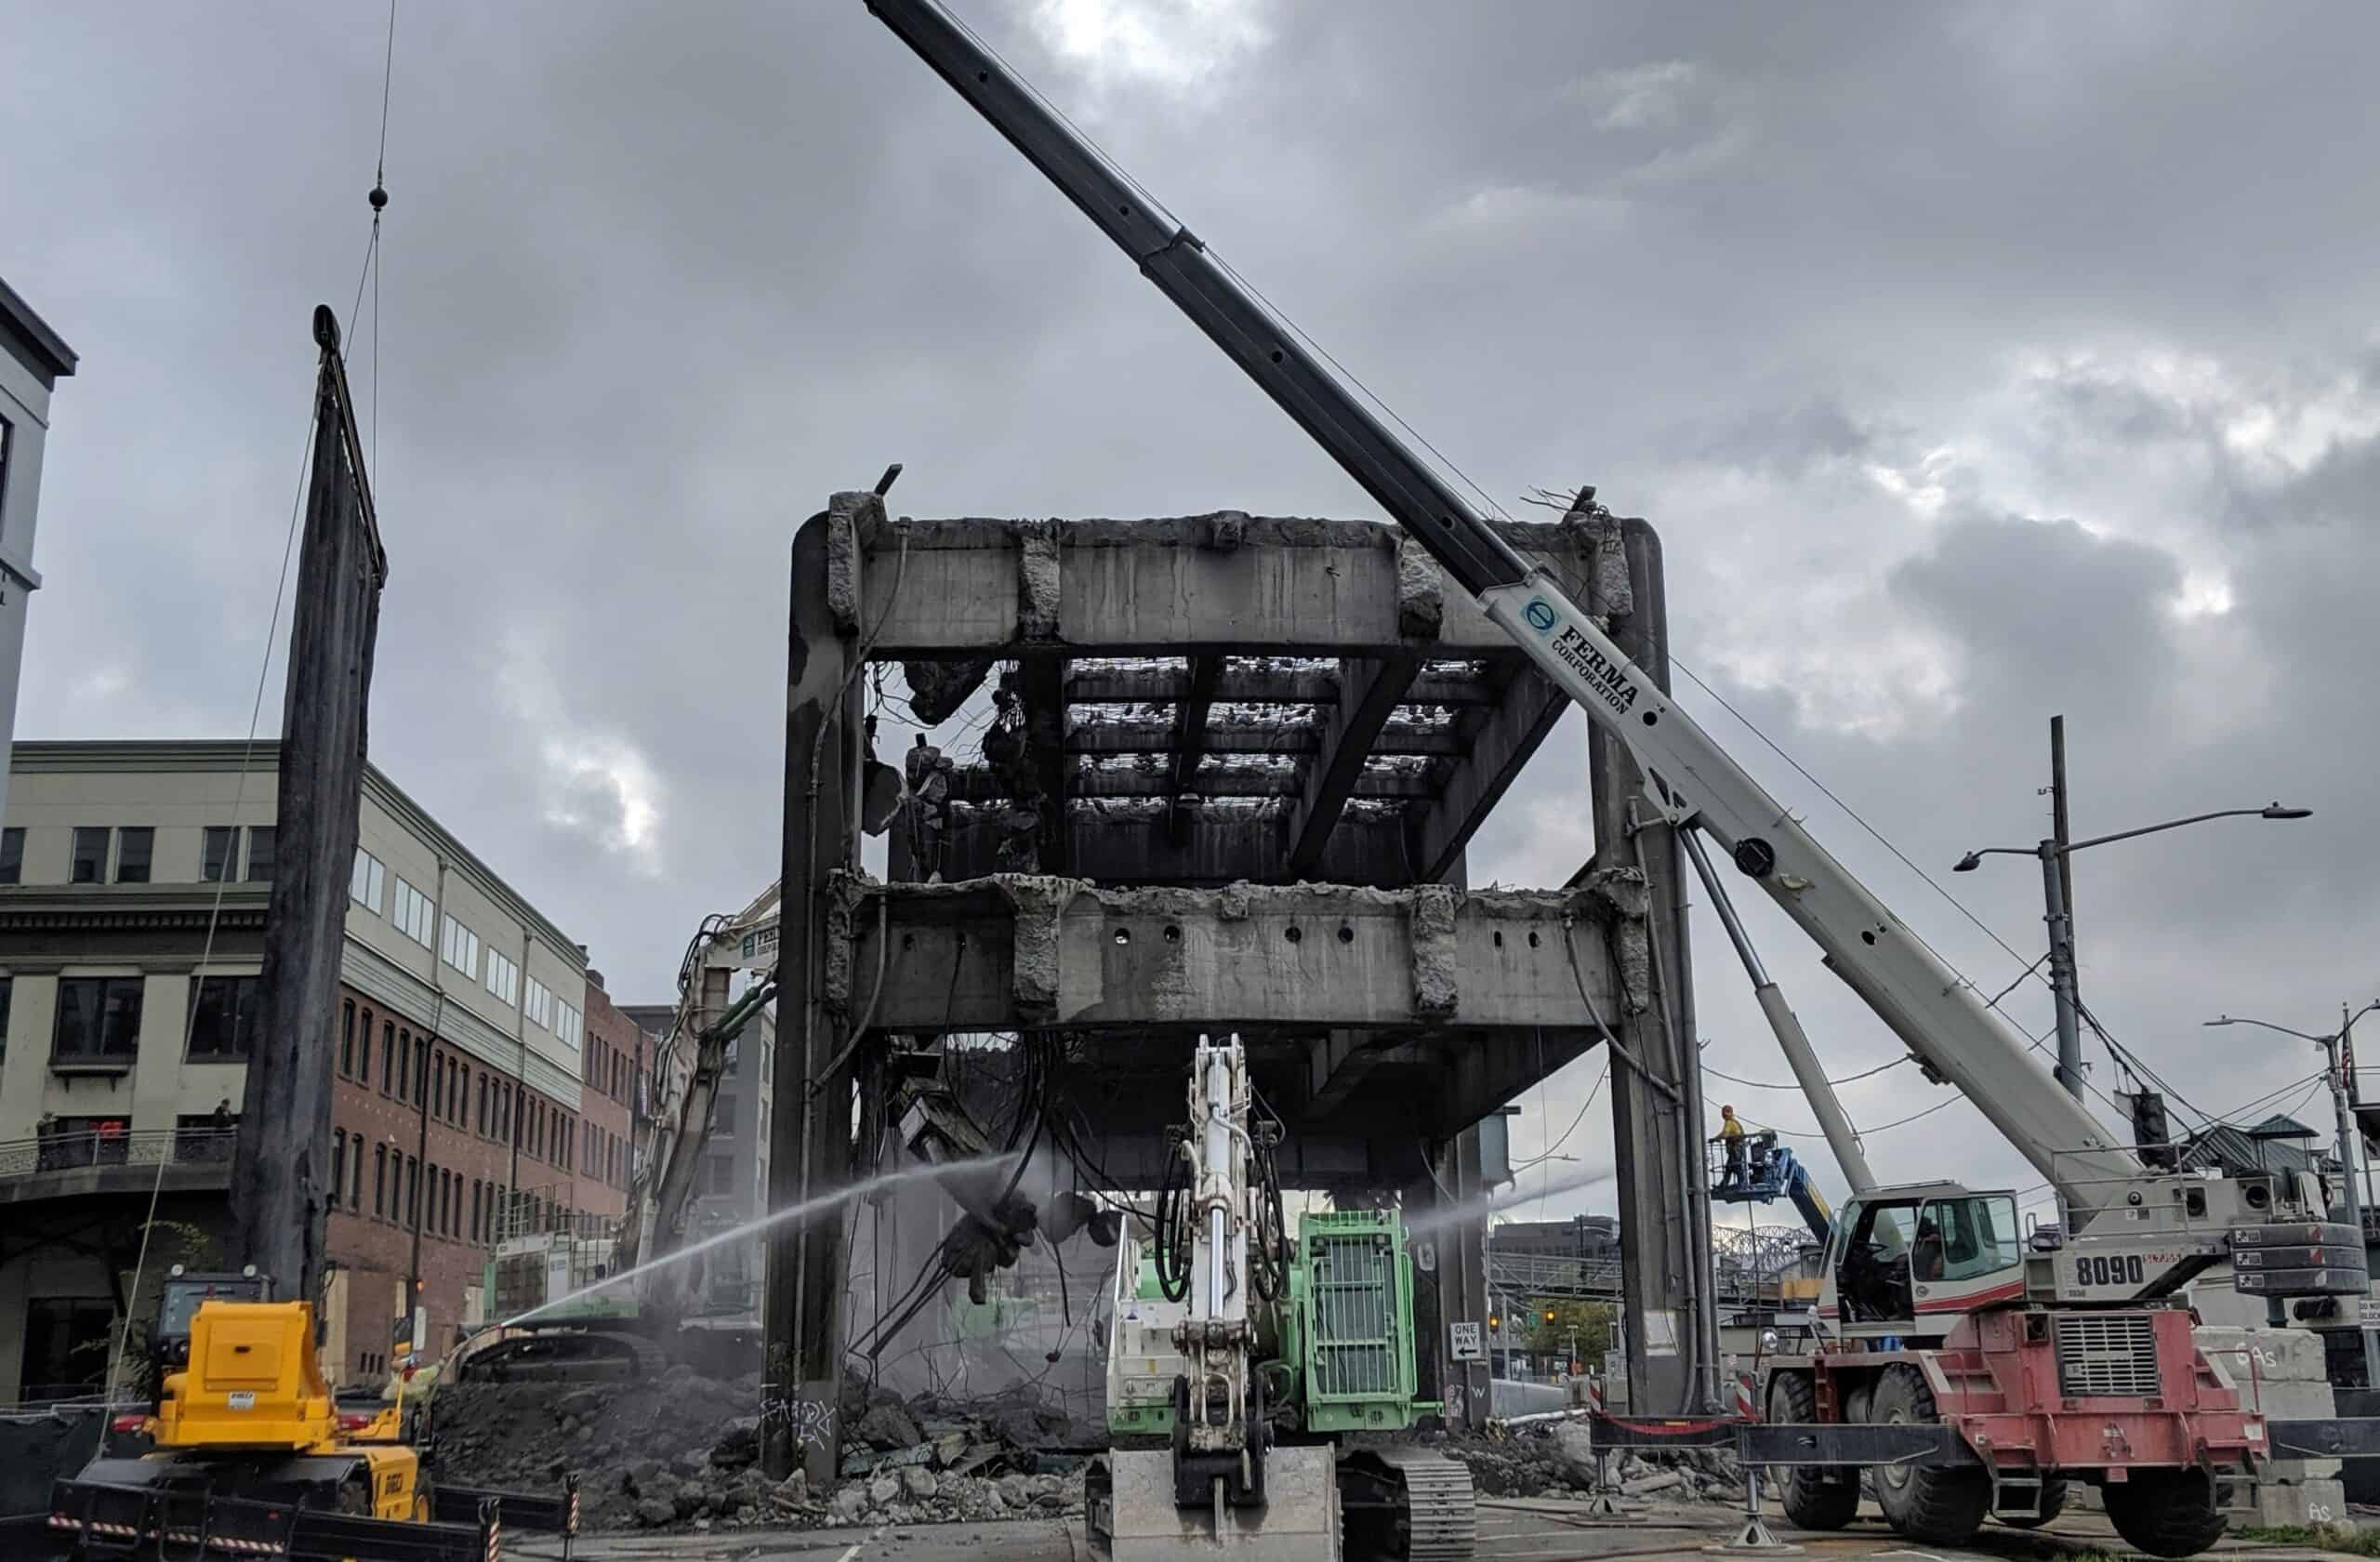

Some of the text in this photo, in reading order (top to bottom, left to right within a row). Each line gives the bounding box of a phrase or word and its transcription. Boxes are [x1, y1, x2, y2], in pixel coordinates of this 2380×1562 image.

[1552, 639, 1630, 715] CORPORATION
[1559, 624, 1638, 708] FERMA
[2076, 1254, 2145, 1286] 8090
[1455, 1323, 1477, 1335] ONE
[1455, 1335, 1477, 1346] WAY
[1471, 1385, 1486, 1399] W
